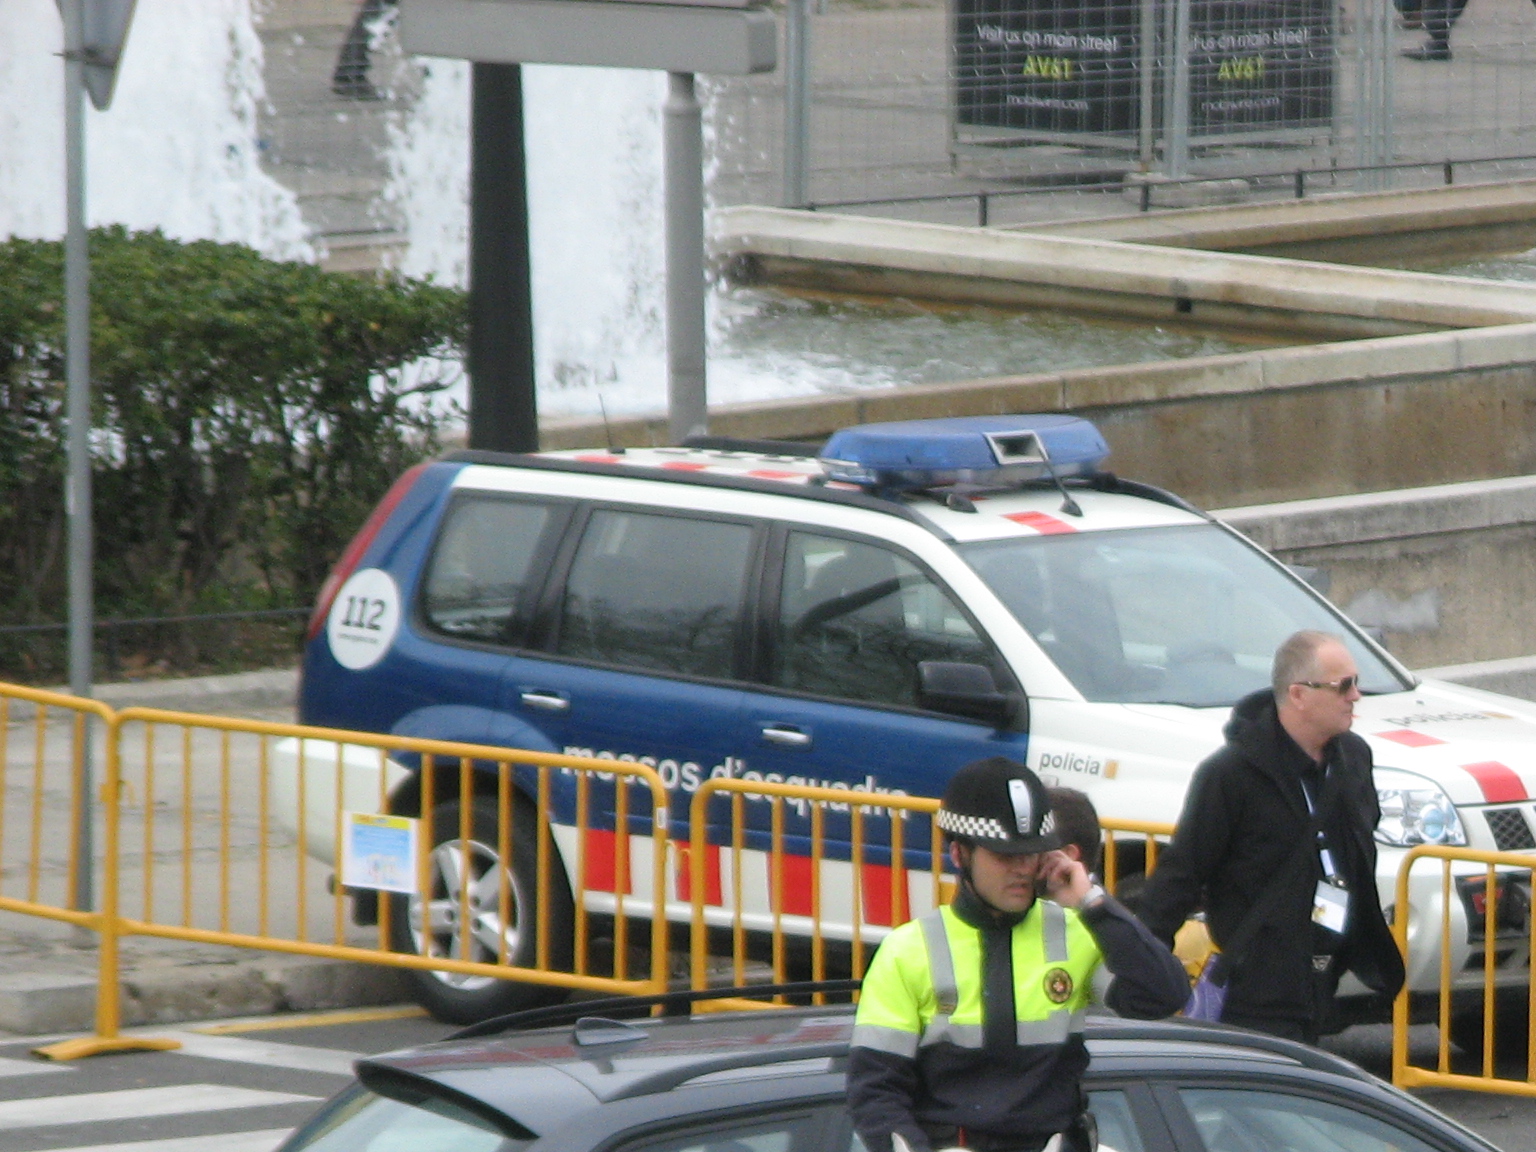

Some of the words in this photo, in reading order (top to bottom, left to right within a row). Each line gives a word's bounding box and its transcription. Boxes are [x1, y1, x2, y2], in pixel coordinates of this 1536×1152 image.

[1005, 31, 1020, 44] us
[1023, 30, 1041, 46] on
[1044, 33, 1077, 48] main
[1080, 34, 1117, 51] street
[341, 595, 386, 631] 112
[1382, 711, 1490, 728] policia
[1039, 752, 1100, 775] policia
